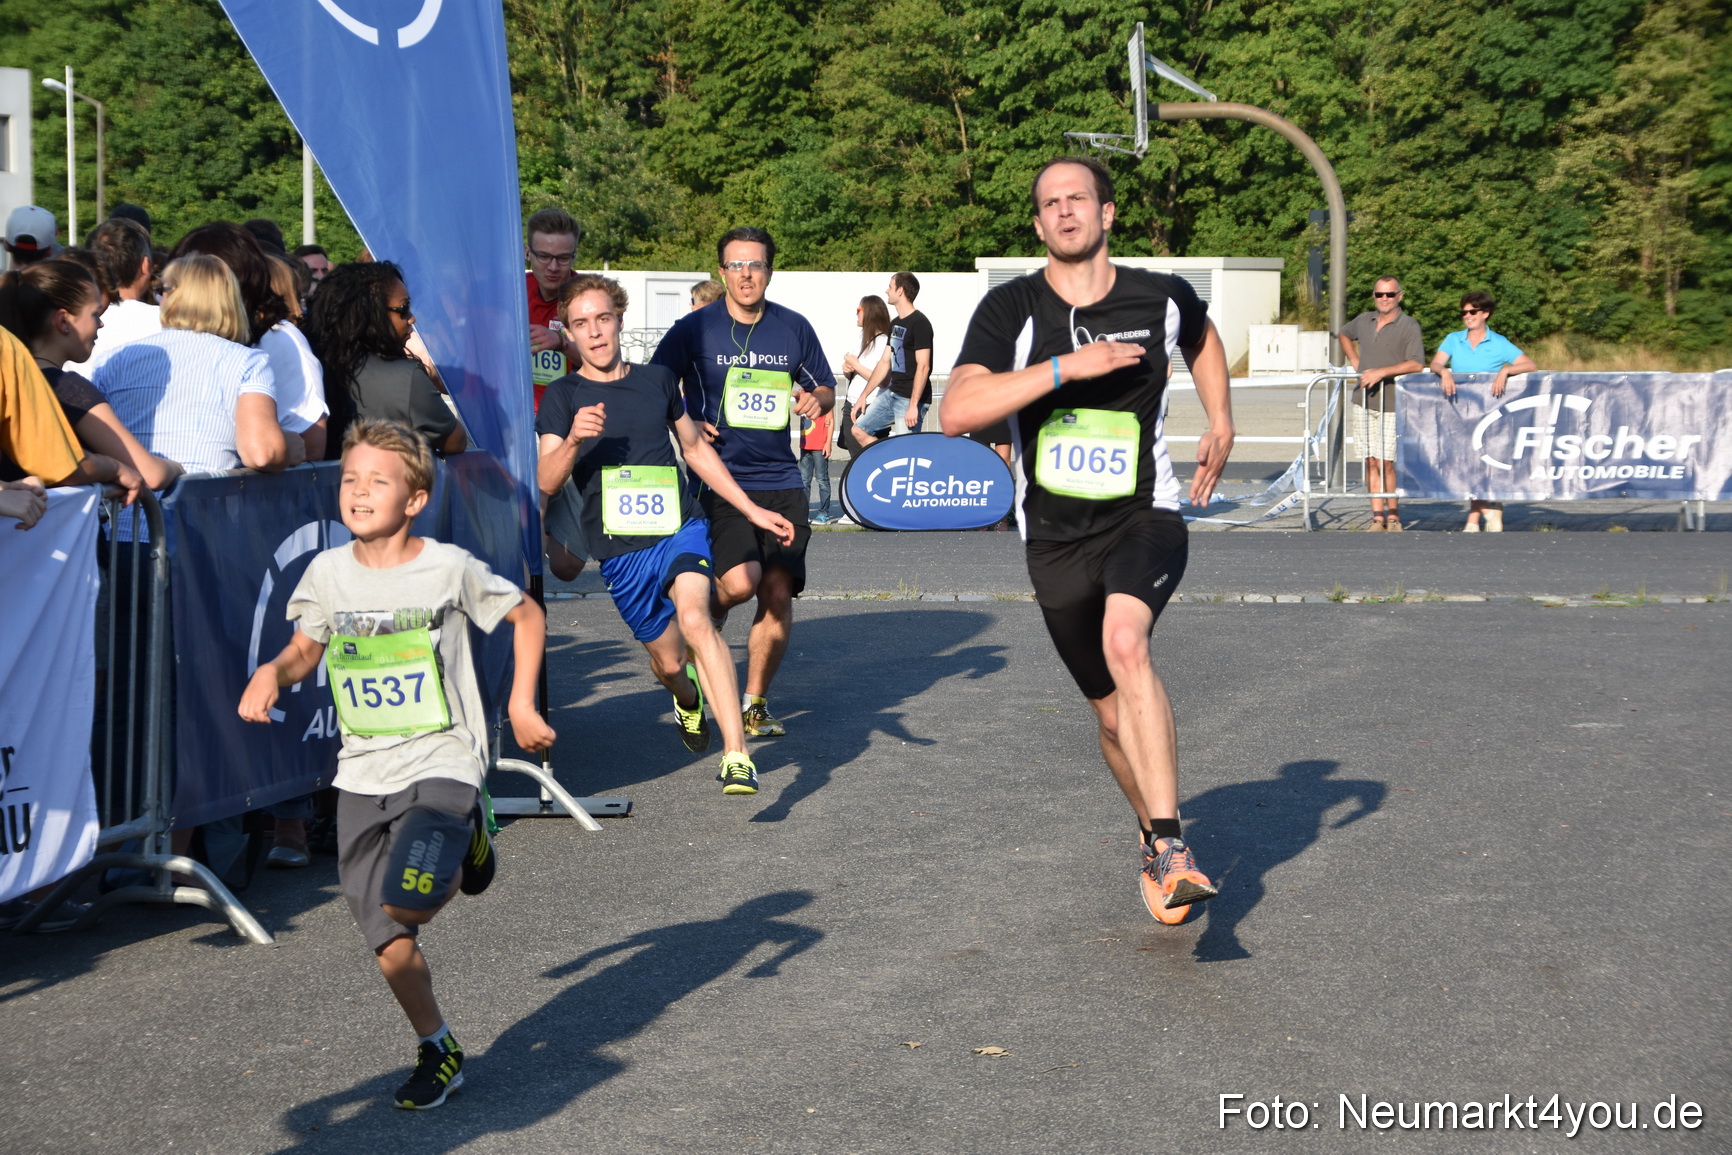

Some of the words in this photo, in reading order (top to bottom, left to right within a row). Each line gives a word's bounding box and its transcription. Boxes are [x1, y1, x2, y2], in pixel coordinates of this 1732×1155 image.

[1113, 329, 1151, 340] PFLEIDERER
[716, 354, 748, 365] EURO
[758, 354, 789, 366] POLES
[737, 392, 777, 413] 385
[1512, 425, 1702, 460] Fischer
[1049, 443, 1127, 475] 1065
[1530, 464, 1686, 480] AUTOMOBILE
[890, 475, 994, 497] Fischer
[618, 494, 665, 516] 858
[902, 498, 988, 508] AUTOMOBILE
[341, 671, 425, 709] 1537
[406, 840, 427, 867] MAD
[421, 831, 445, 873] WORLD
[401, 867, 434, 895] 56
